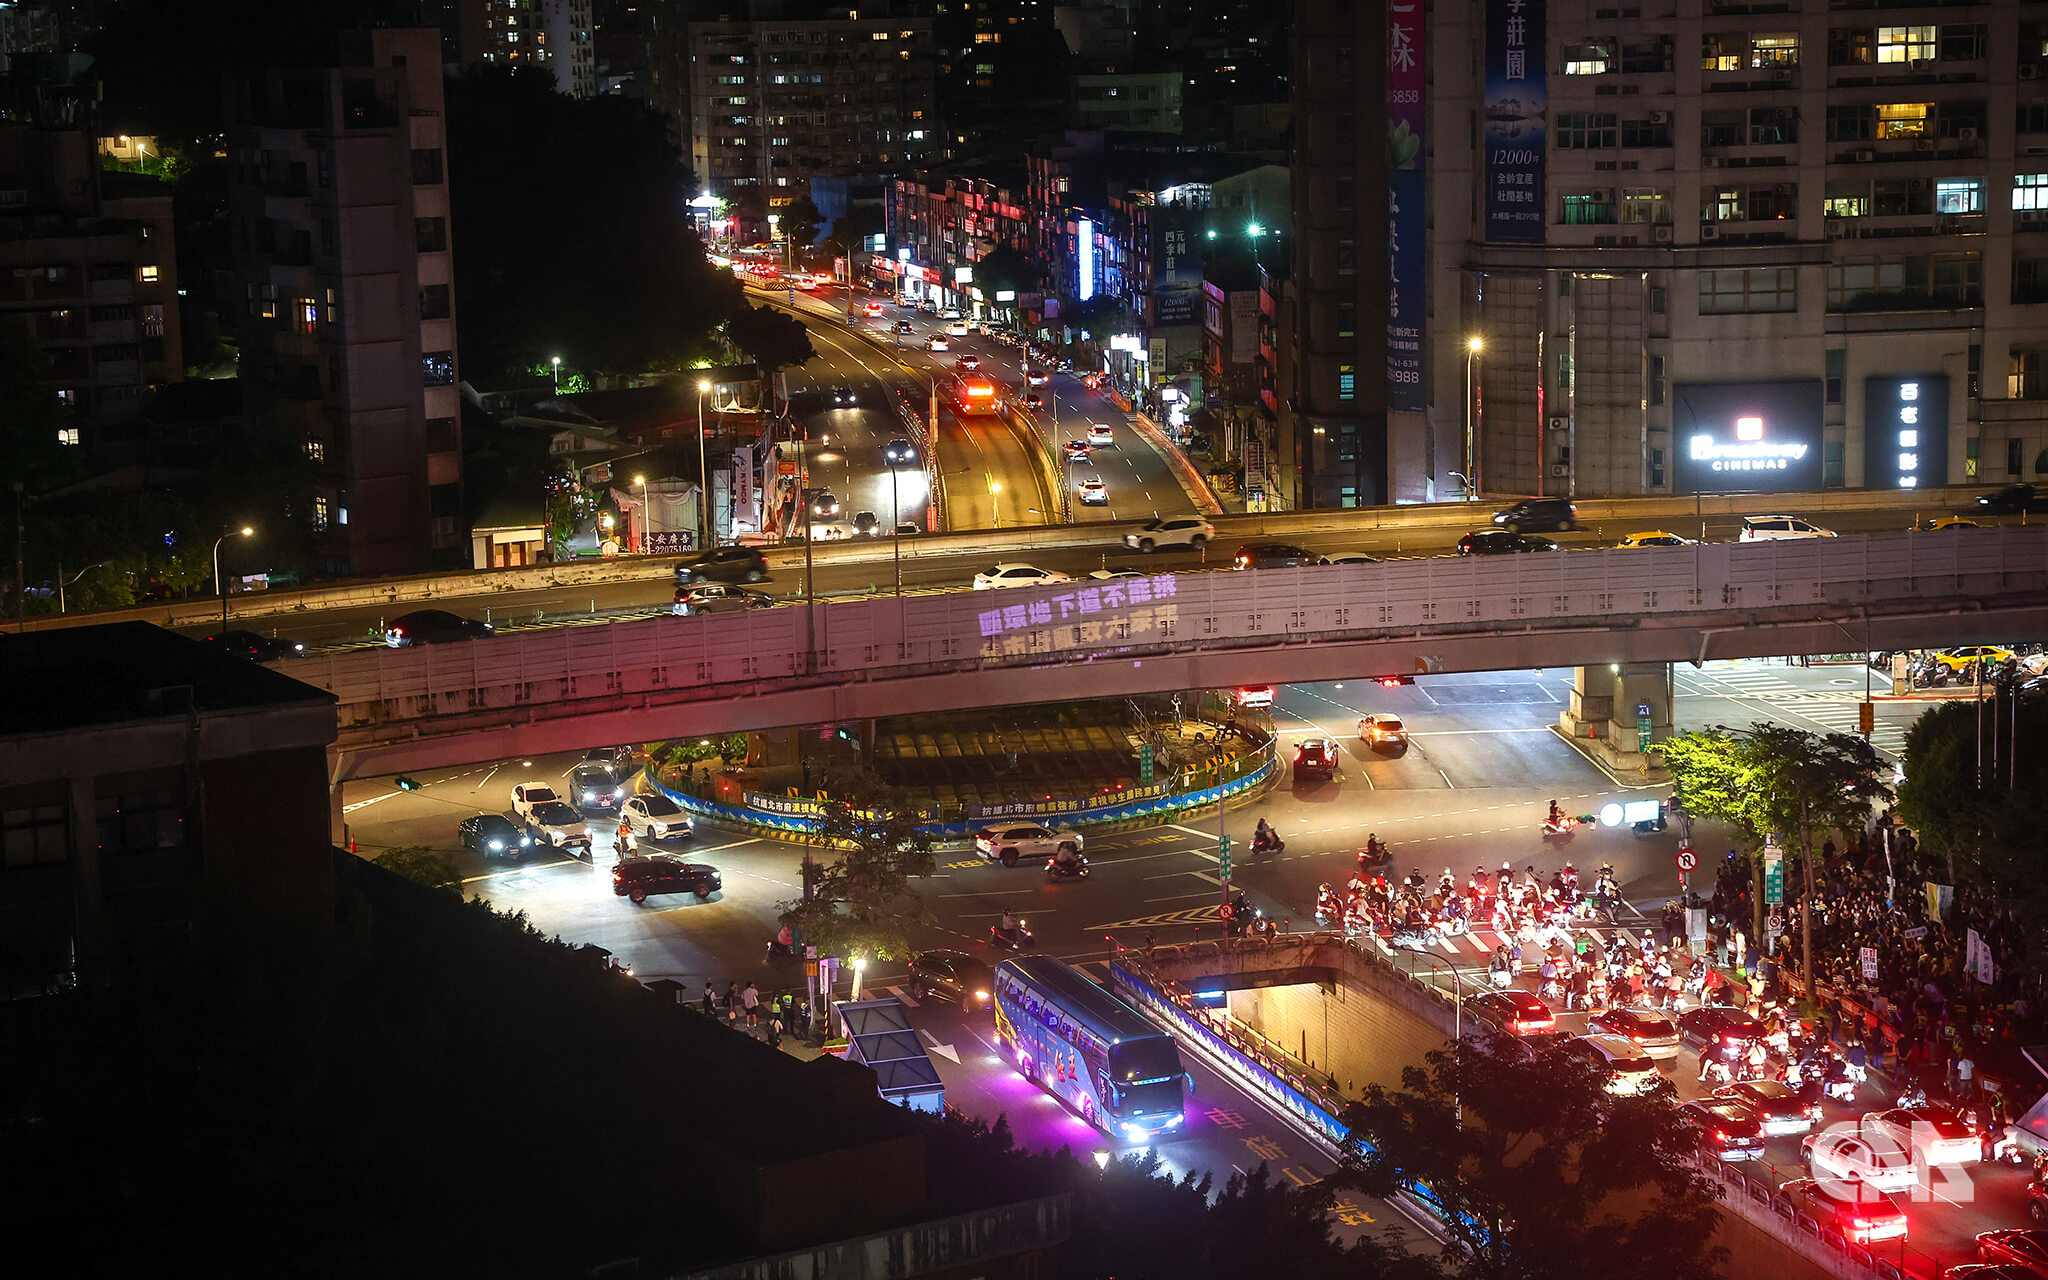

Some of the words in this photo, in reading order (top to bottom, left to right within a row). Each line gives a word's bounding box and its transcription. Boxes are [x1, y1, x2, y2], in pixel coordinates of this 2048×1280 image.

[1391, 0, 1416, 73] 森
[1711, 459, 1787, 471] CINEMAS
[739, 472, 747, 505] KYMCO
